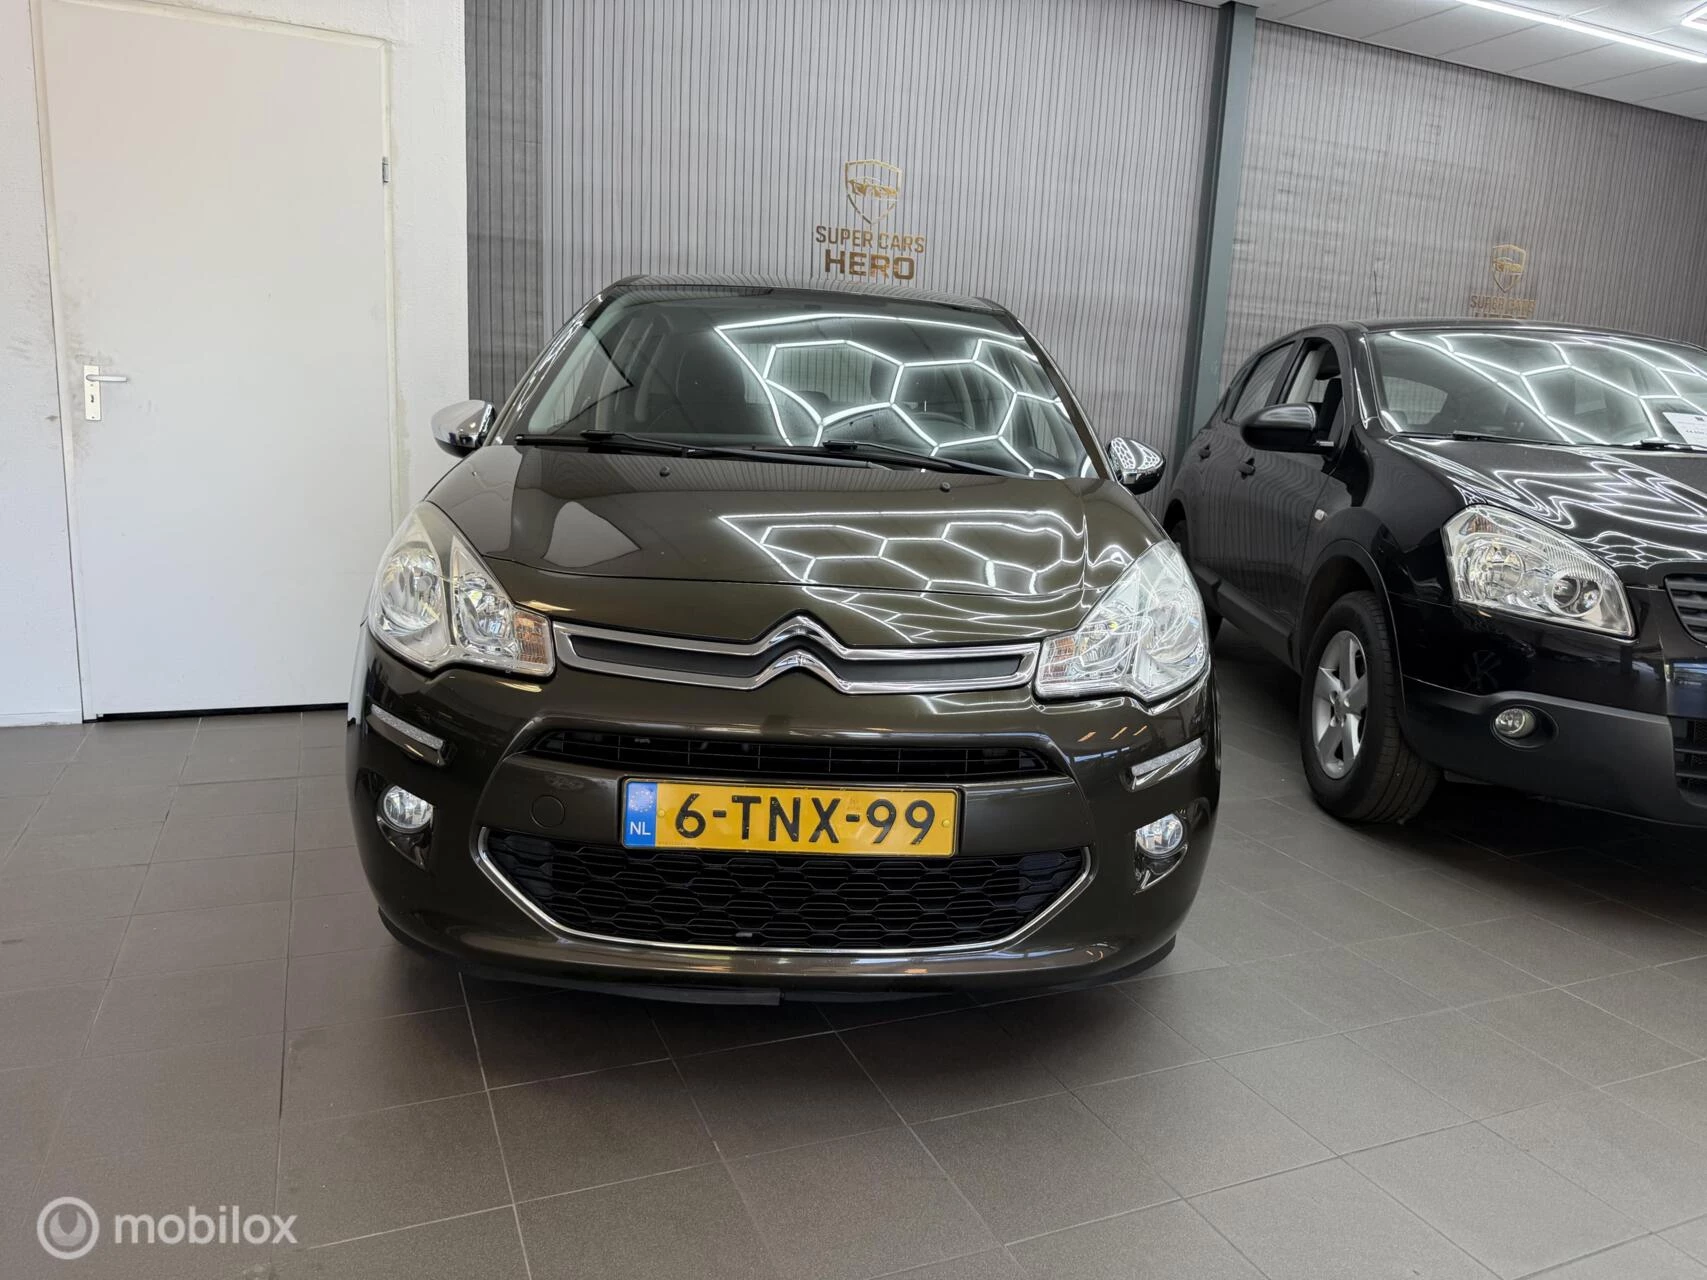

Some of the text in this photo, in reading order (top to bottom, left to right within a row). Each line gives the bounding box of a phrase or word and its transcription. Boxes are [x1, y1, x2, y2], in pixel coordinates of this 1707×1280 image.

[815, 225, 926, 254] SUPER CARS
[824, 249, 915, 280] HERO
[630, 821, 651, 836] NL
[675, 793, 936, 845] 6-TNX-99
